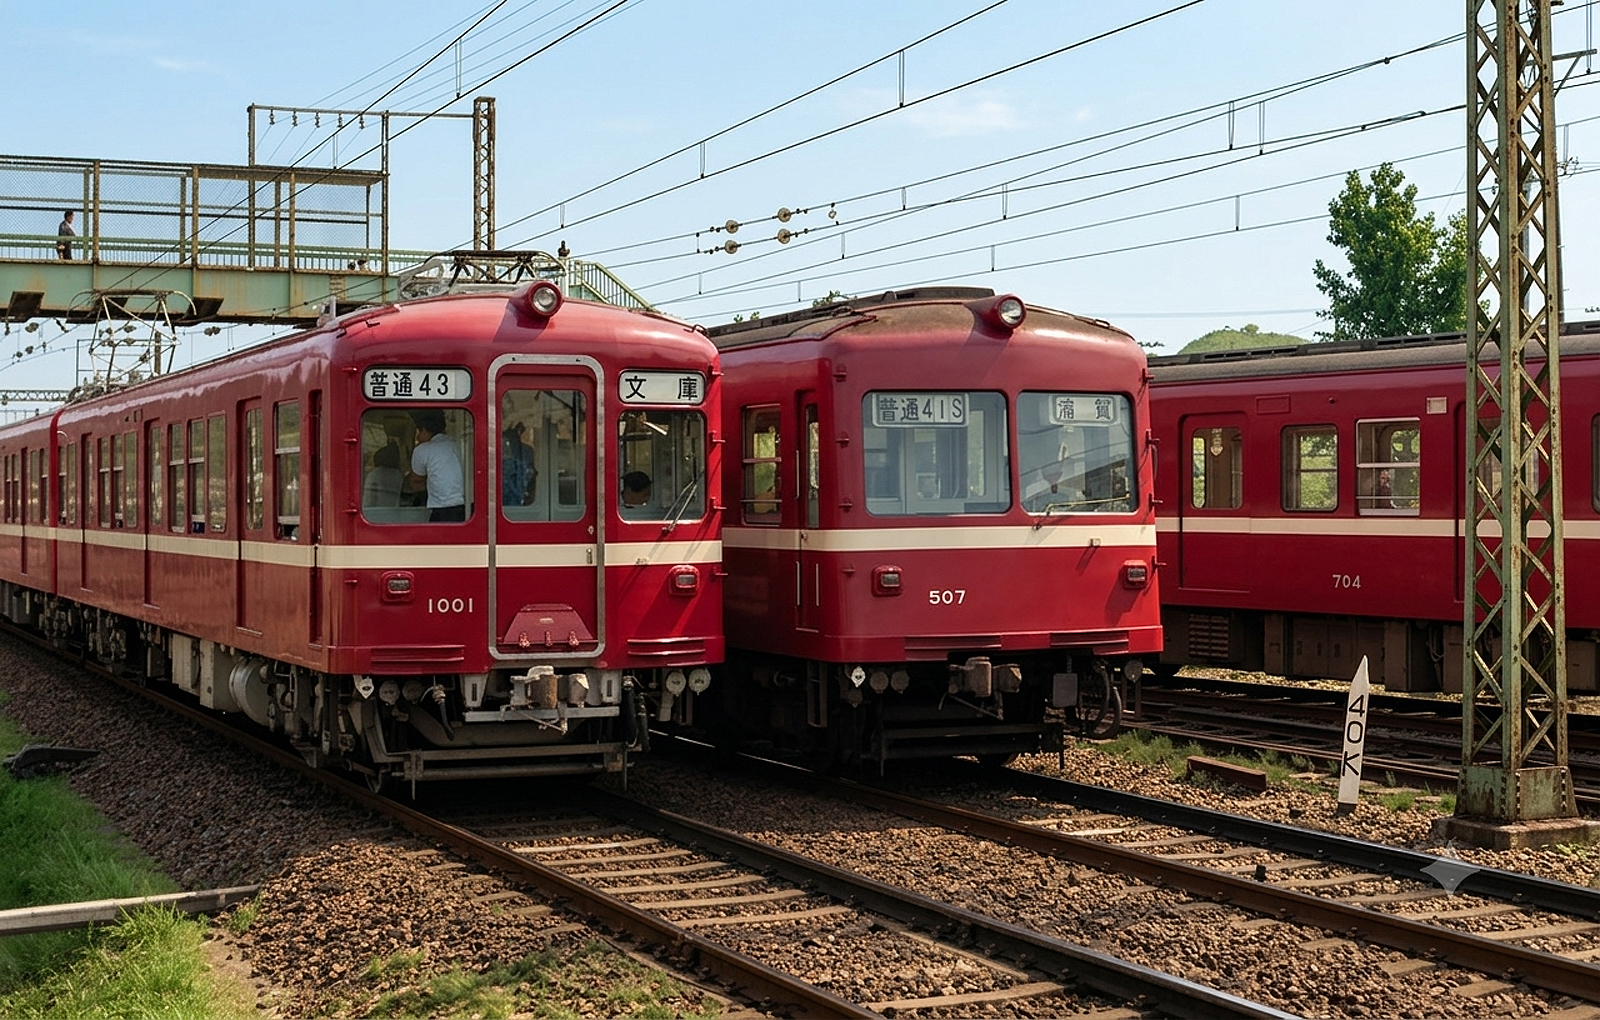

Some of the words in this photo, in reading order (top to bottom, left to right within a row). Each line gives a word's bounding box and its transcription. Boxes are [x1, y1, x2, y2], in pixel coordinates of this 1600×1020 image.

[369, 371, 449, 398] 普通43
[624, 374, 699, 401] 文庫
[879, 396, 963, 422] 普通41S
[1332, 574, 1361, 590] 704
[427, 597, 474, 614] 1001
[929, 589, 966, 606] 507
[1341, 694, 1366, 777] 40K
